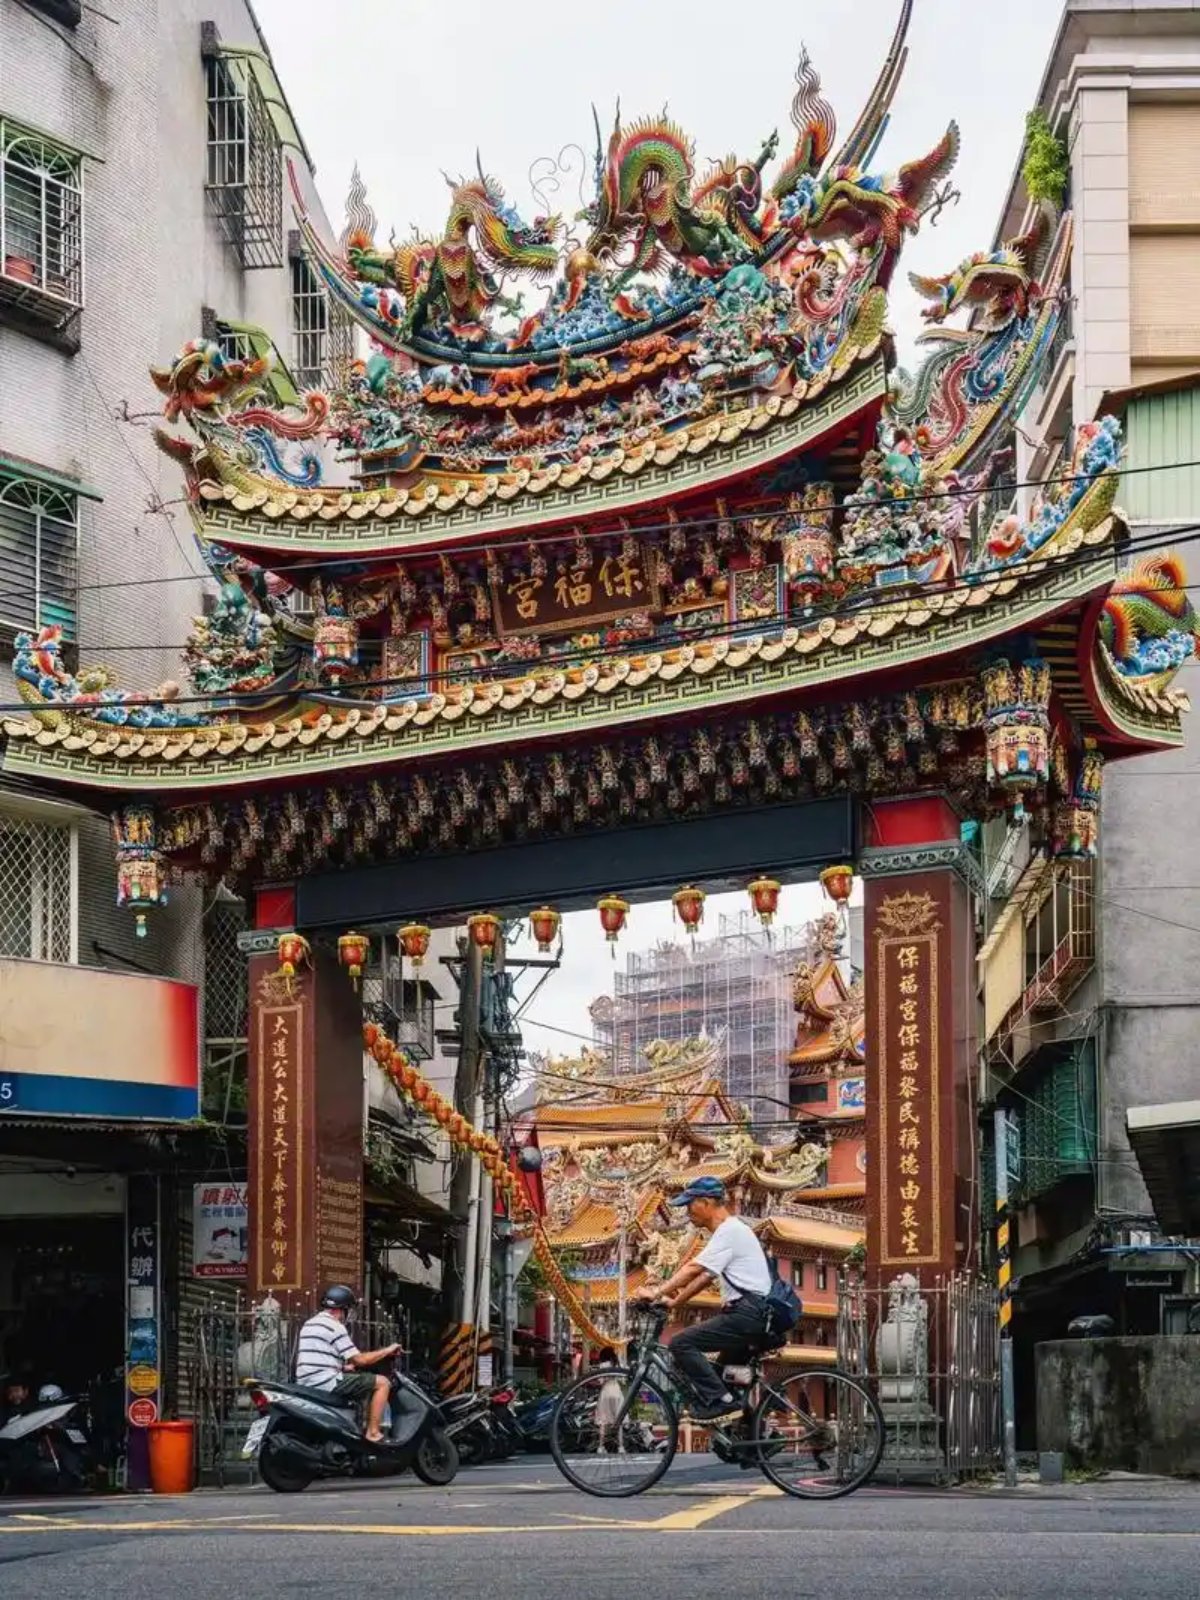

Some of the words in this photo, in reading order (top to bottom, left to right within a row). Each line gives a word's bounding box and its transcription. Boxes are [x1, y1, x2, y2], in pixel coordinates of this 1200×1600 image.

[507, 553, 643, 619] 保福宮
[131, 1226, 154, 1276] 代辦
